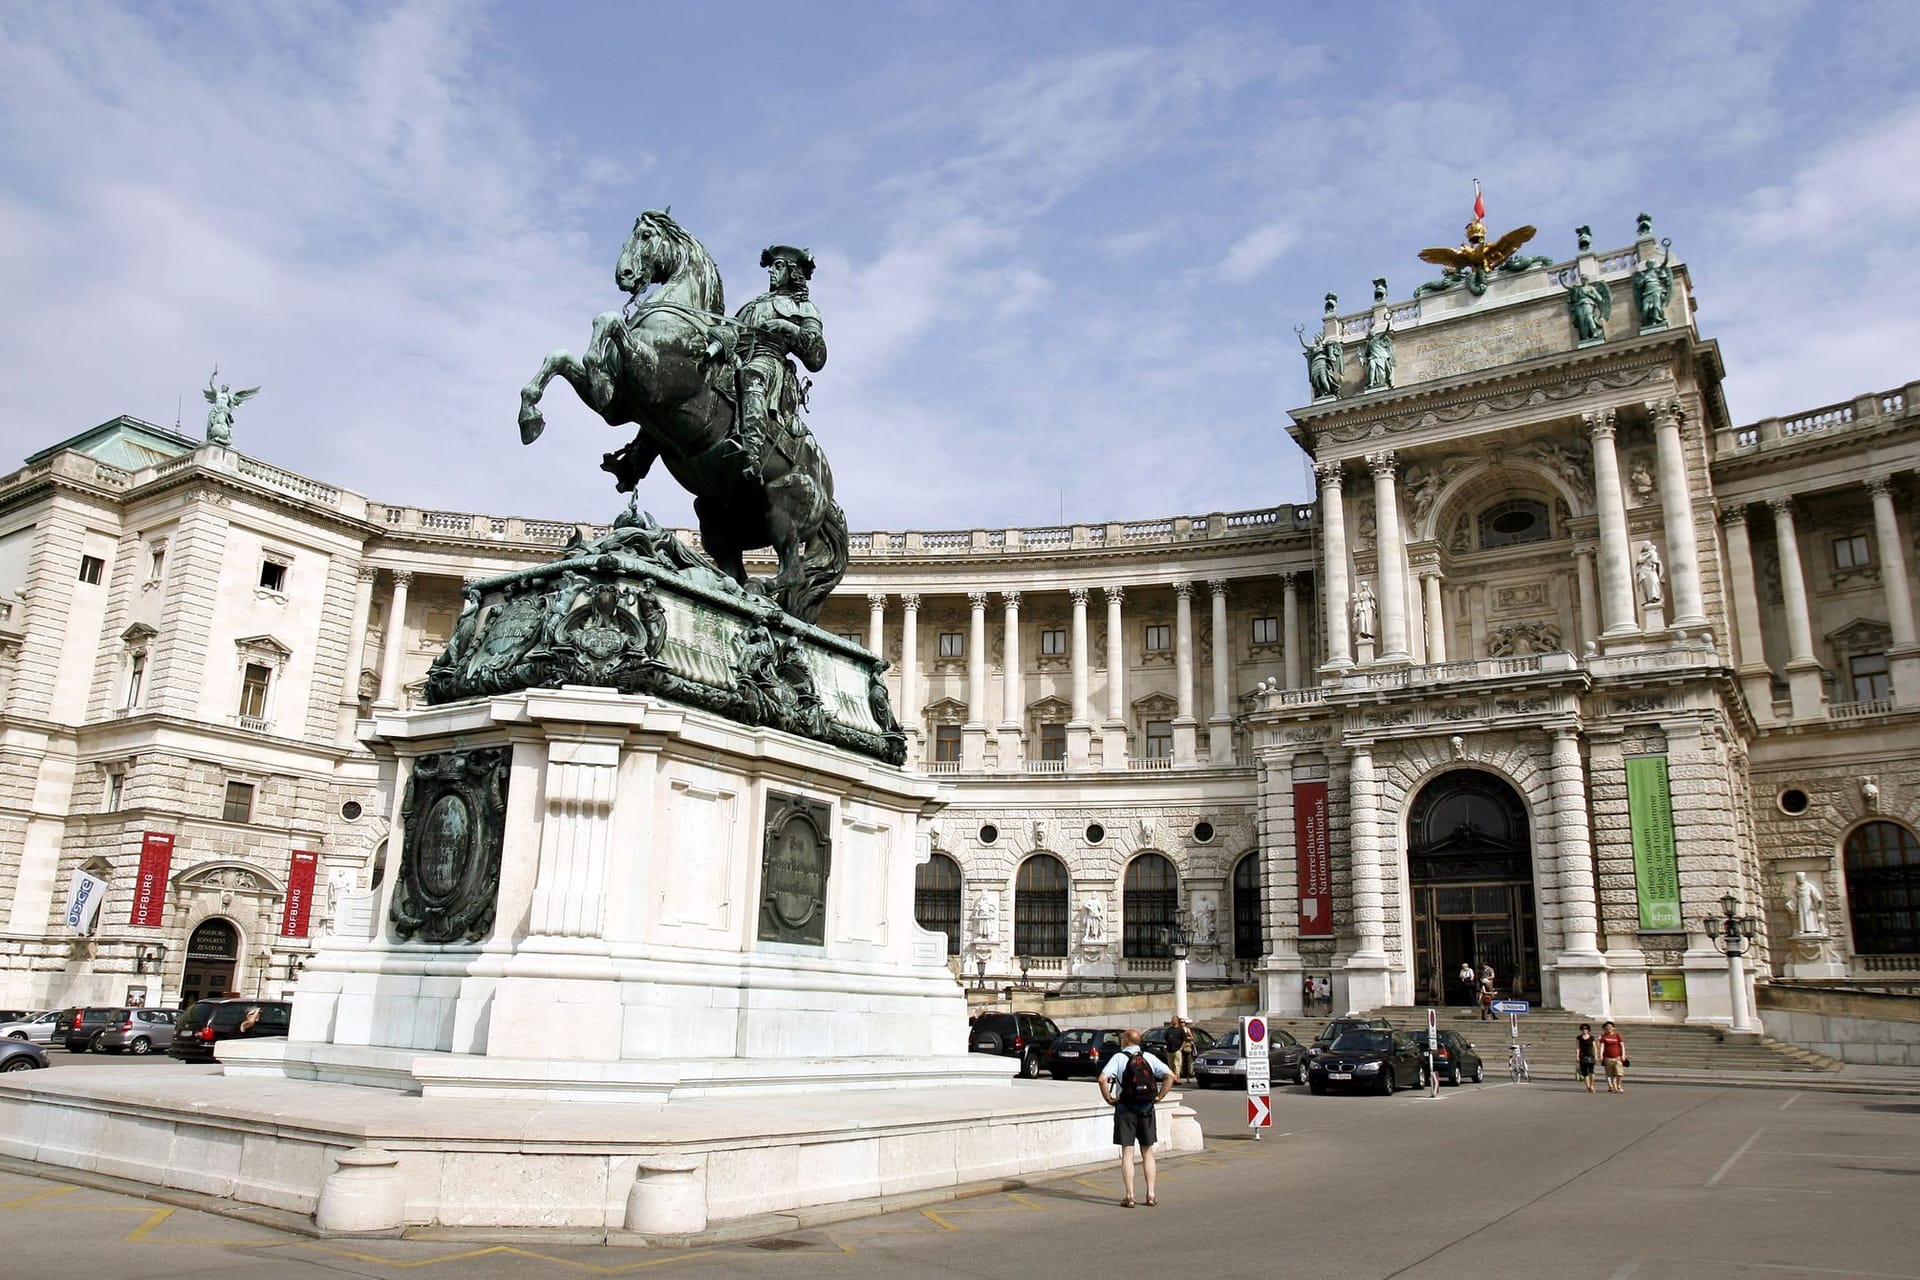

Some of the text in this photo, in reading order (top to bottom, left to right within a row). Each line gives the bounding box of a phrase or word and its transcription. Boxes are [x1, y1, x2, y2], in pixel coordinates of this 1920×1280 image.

[1306, 816, 1317, 895] Österreichische
[1315, 798, 1327, 894] Nationalbibliothek
[1643, 828, 1658, 900] ephesos museum
[1653, 845, 1662, 862] und
[137, 874, 153, 924] HOFBURG
[1664, 855, 1676, 899] sammlung
[287, 889, 301, 936] HOFBURG
[1652, 912, 1672, 920] khm
